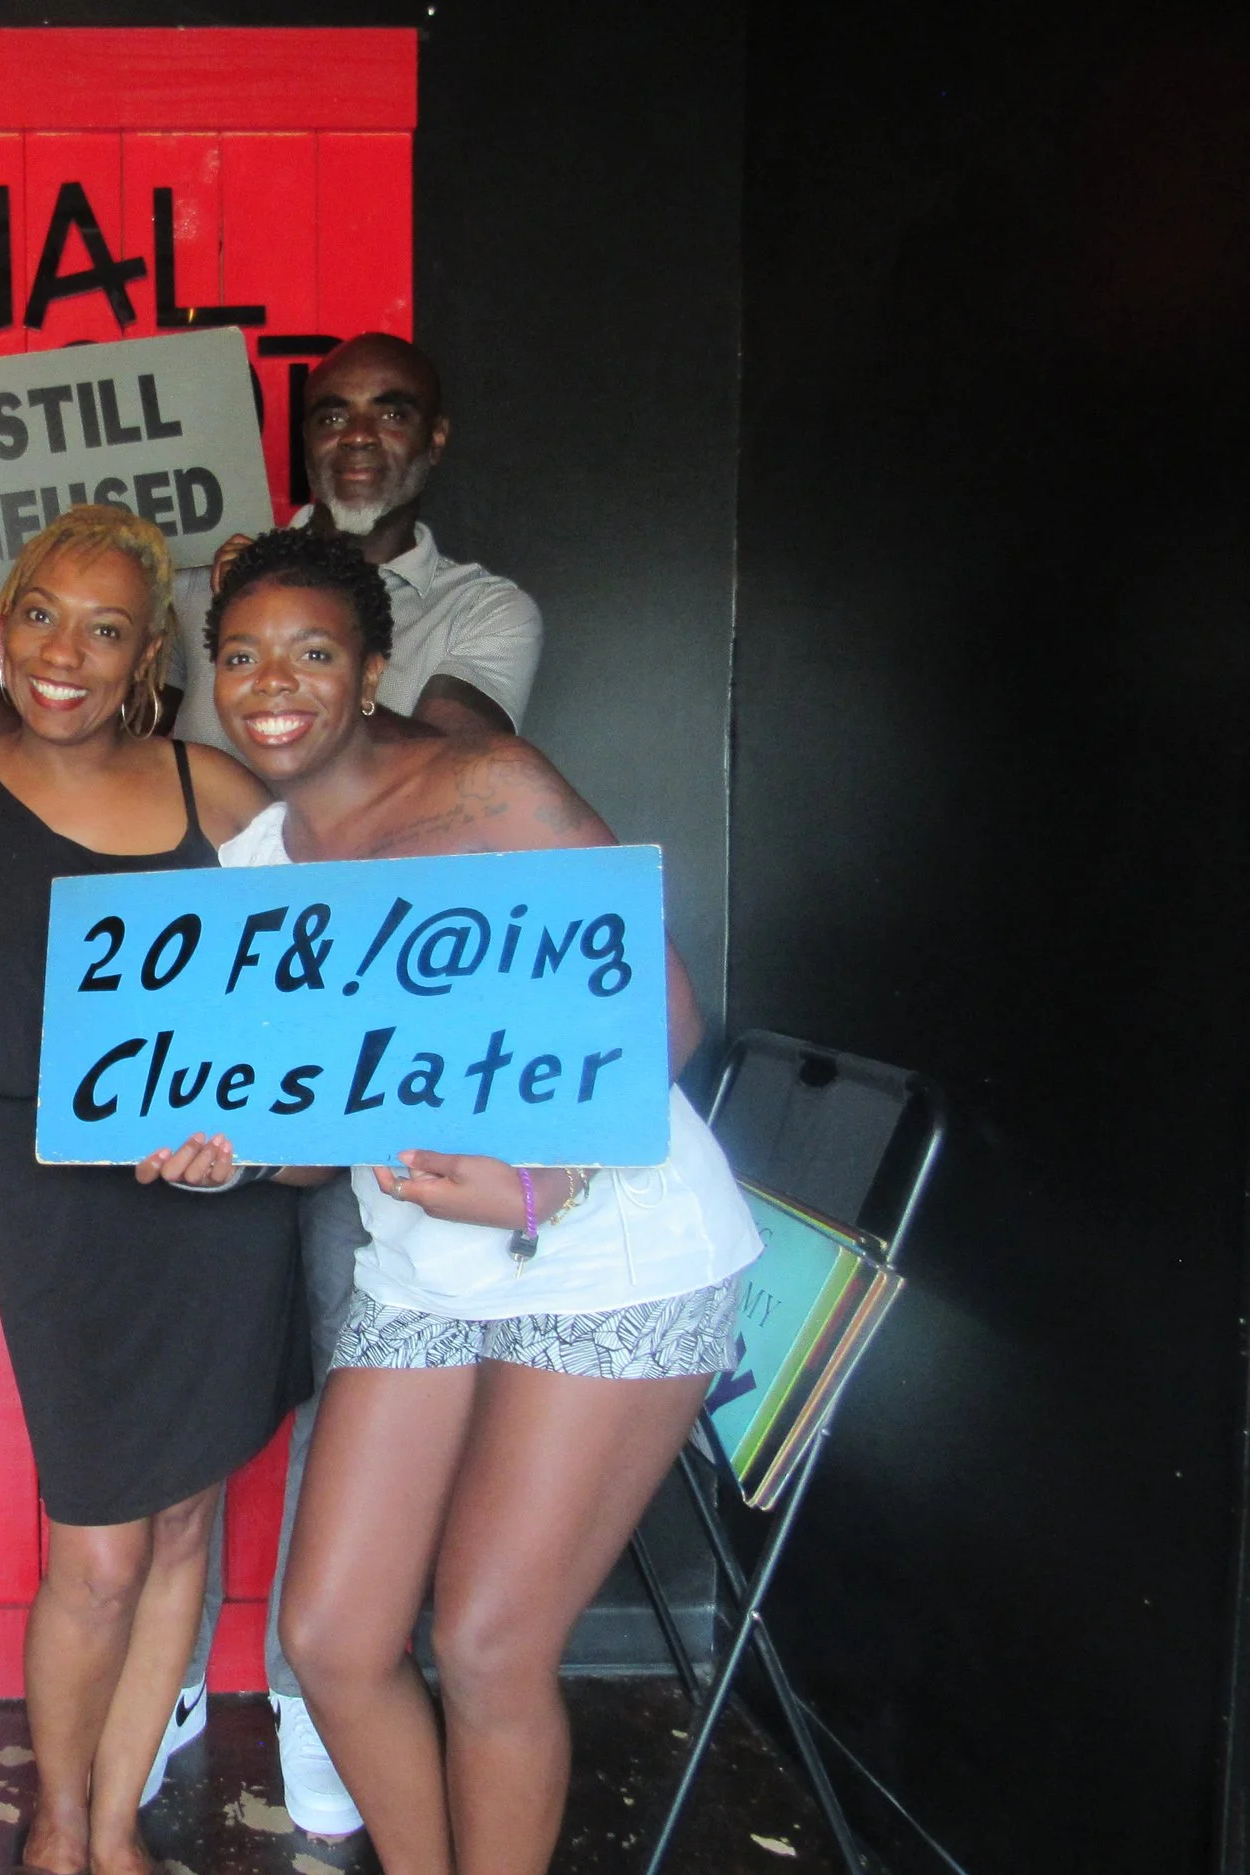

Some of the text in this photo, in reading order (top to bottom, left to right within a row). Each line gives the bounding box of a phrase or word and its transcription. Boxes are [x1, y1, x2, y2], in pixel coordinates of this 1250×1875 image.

[78, 913, 202, 993] 20
[72, 1026, 623, 1123] Clues Later
